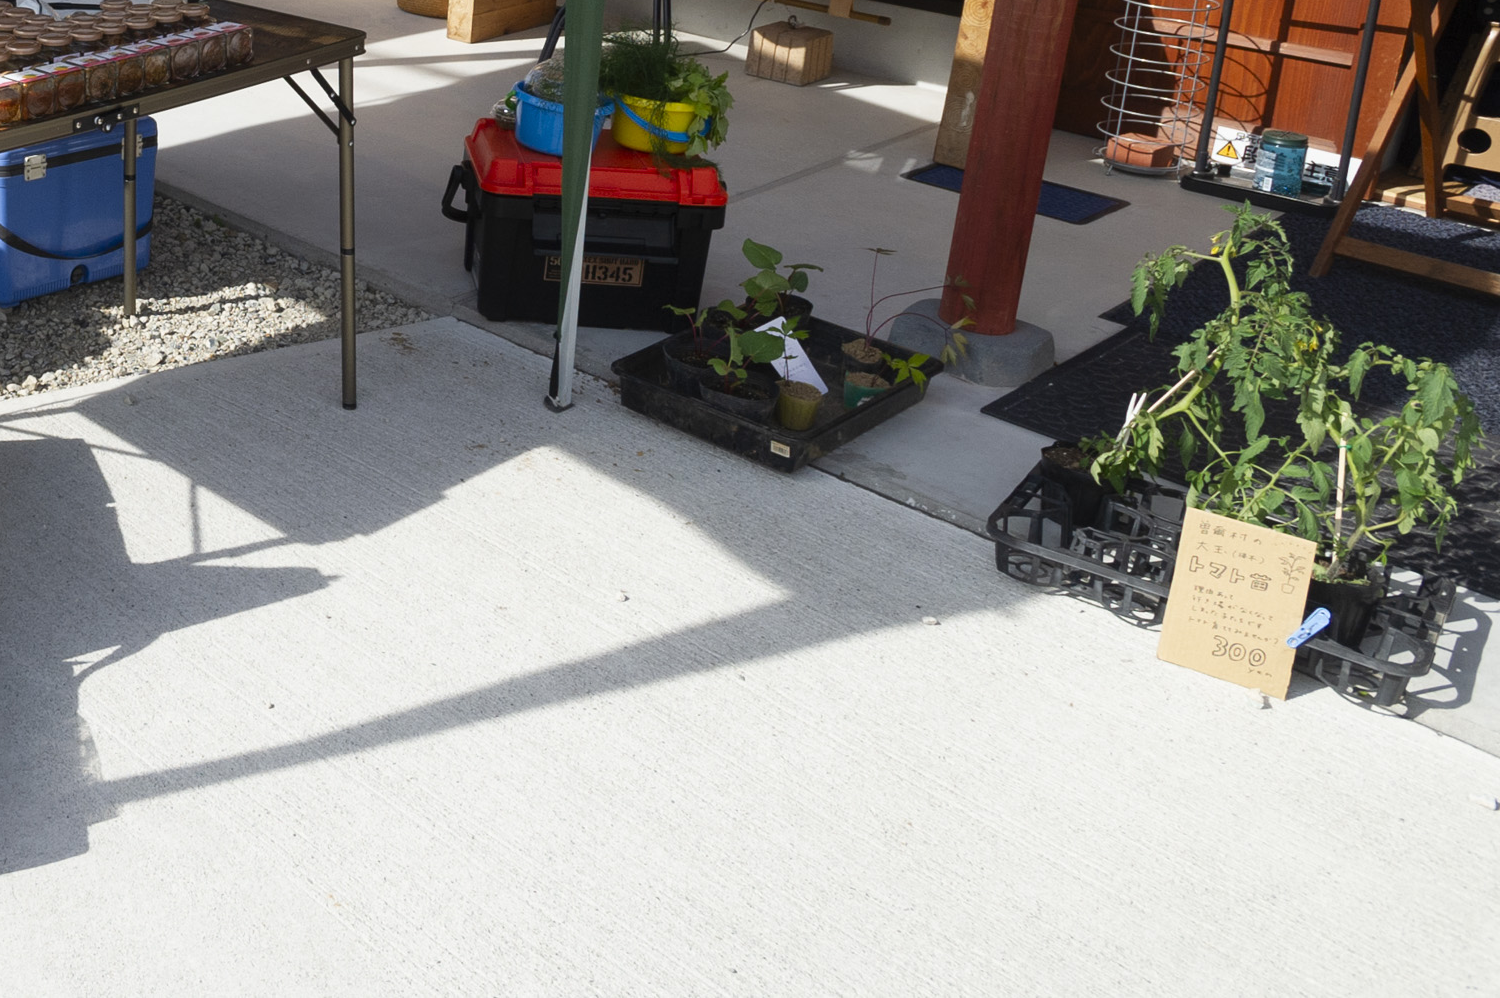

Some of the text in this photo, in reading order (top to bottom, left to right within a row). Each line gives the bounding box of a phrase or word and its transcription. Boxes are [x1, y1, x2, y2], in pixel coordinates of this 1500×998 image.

[584, 264, 633, 283] H345
[1188, 555, 1273, 592] トマト苗
[1212, 635, 1266, 667] 300
